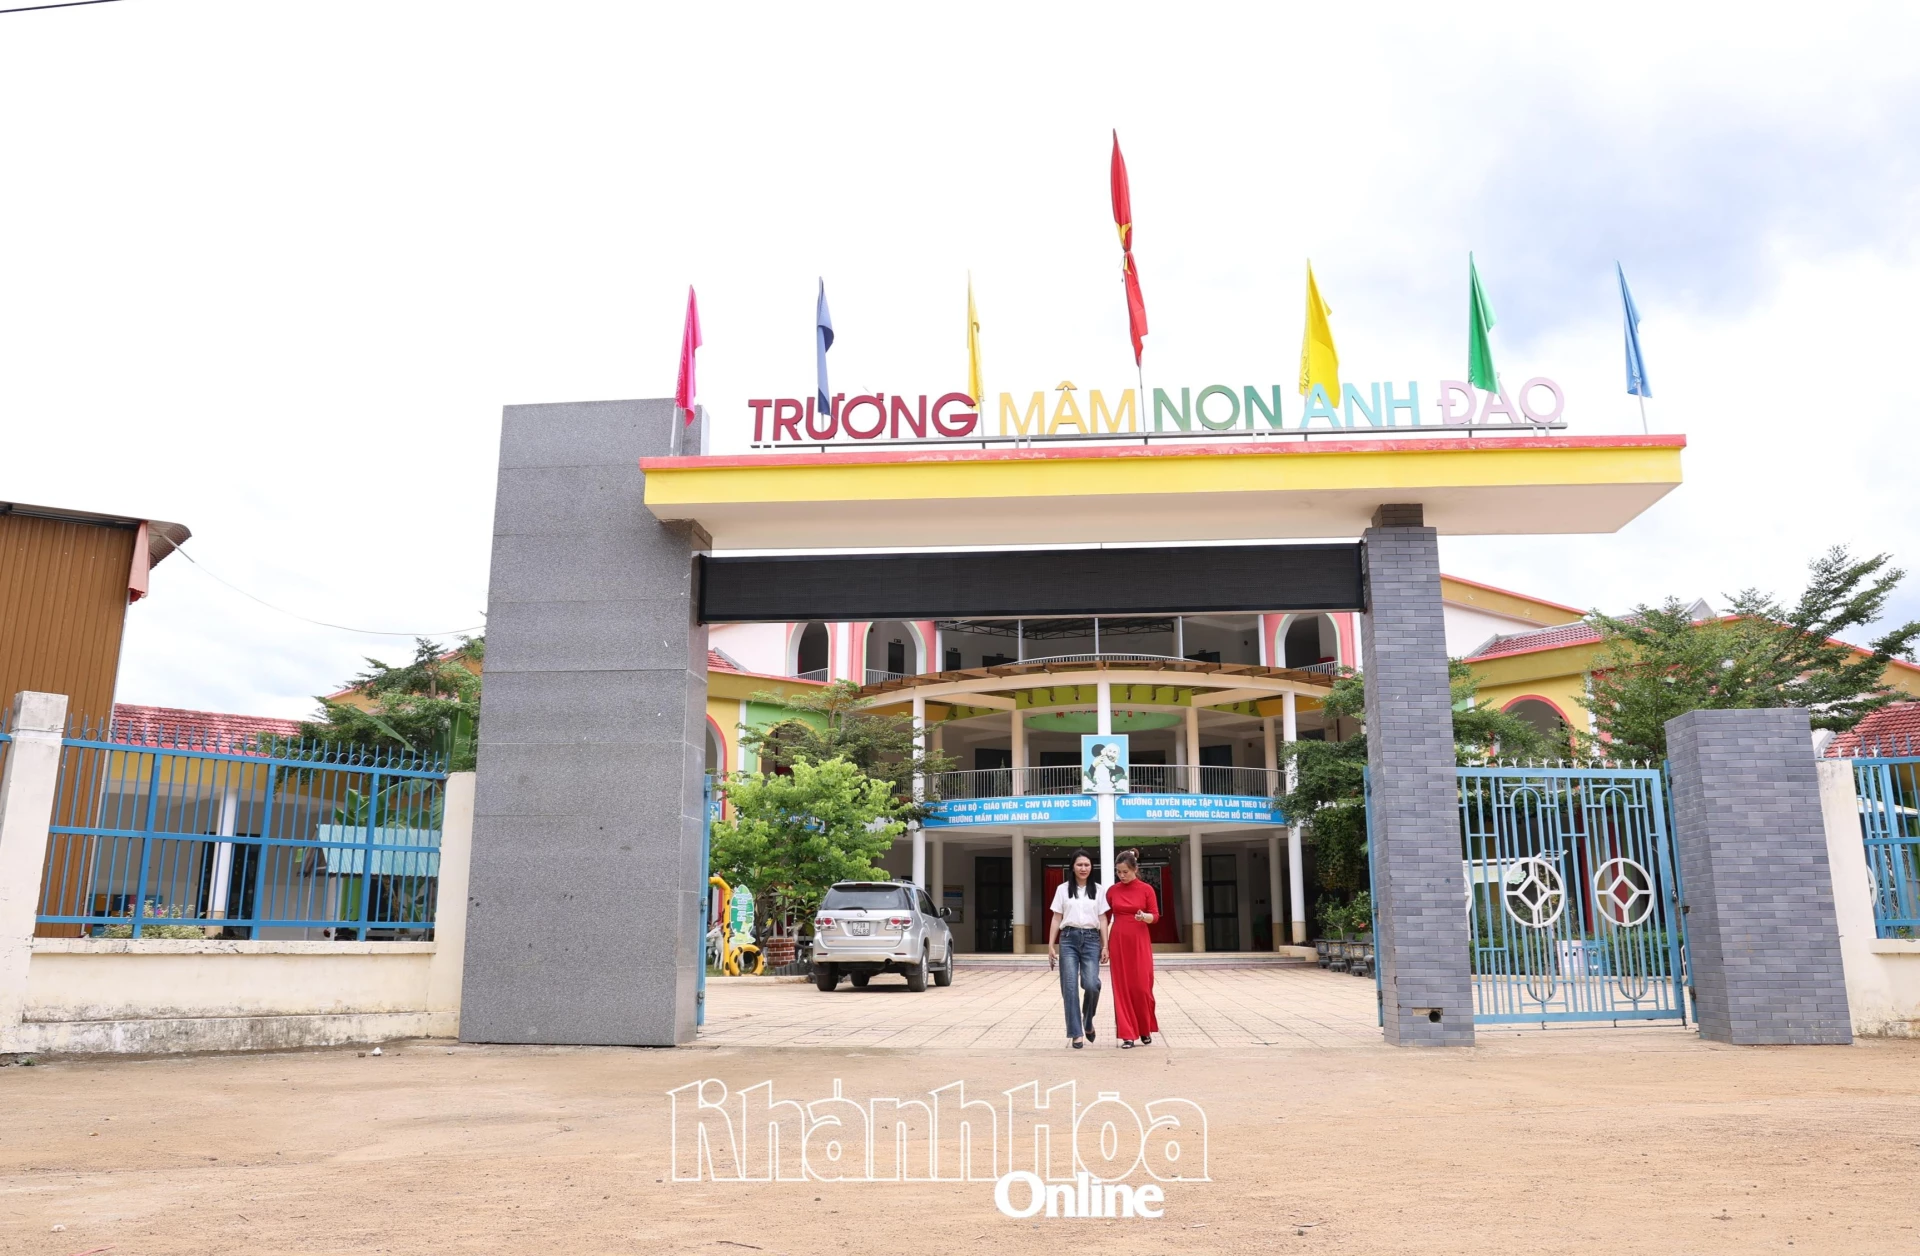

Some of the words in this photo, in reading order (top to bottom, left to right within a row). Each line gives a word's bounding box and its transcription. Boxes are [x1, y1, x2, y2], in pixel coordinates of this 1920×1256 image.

[1153, 384, 1284, 432] NON
[1299, 380, 1421, 428] ANH
[1001, 801, 1019, 810] VIÊN
[1024, 800, 1040, 809] CNV
[1042, 799, 1052, 808] VÀ
[1053, 799, 1070, 809] HỌC
[1072, 799, 1092, 807] SINH
[1155, 797, 1180, 806] XUYÊN
[1182, 798, 1197, 808] HỌC
[1214, 798, 1224, 807] VÀ
[1241, 800, 1257, 809] THEO
[994, 813, 1010, 822] NON
[1011, 812, 1029, 821] ANH
[1184, 810, 1209, 819] PHONG
[1211, 809, 1230, 819] CÁCH
[1242, 810, 1253, 820] CHÍ
[1254, 813, 1272, 821] MINH
